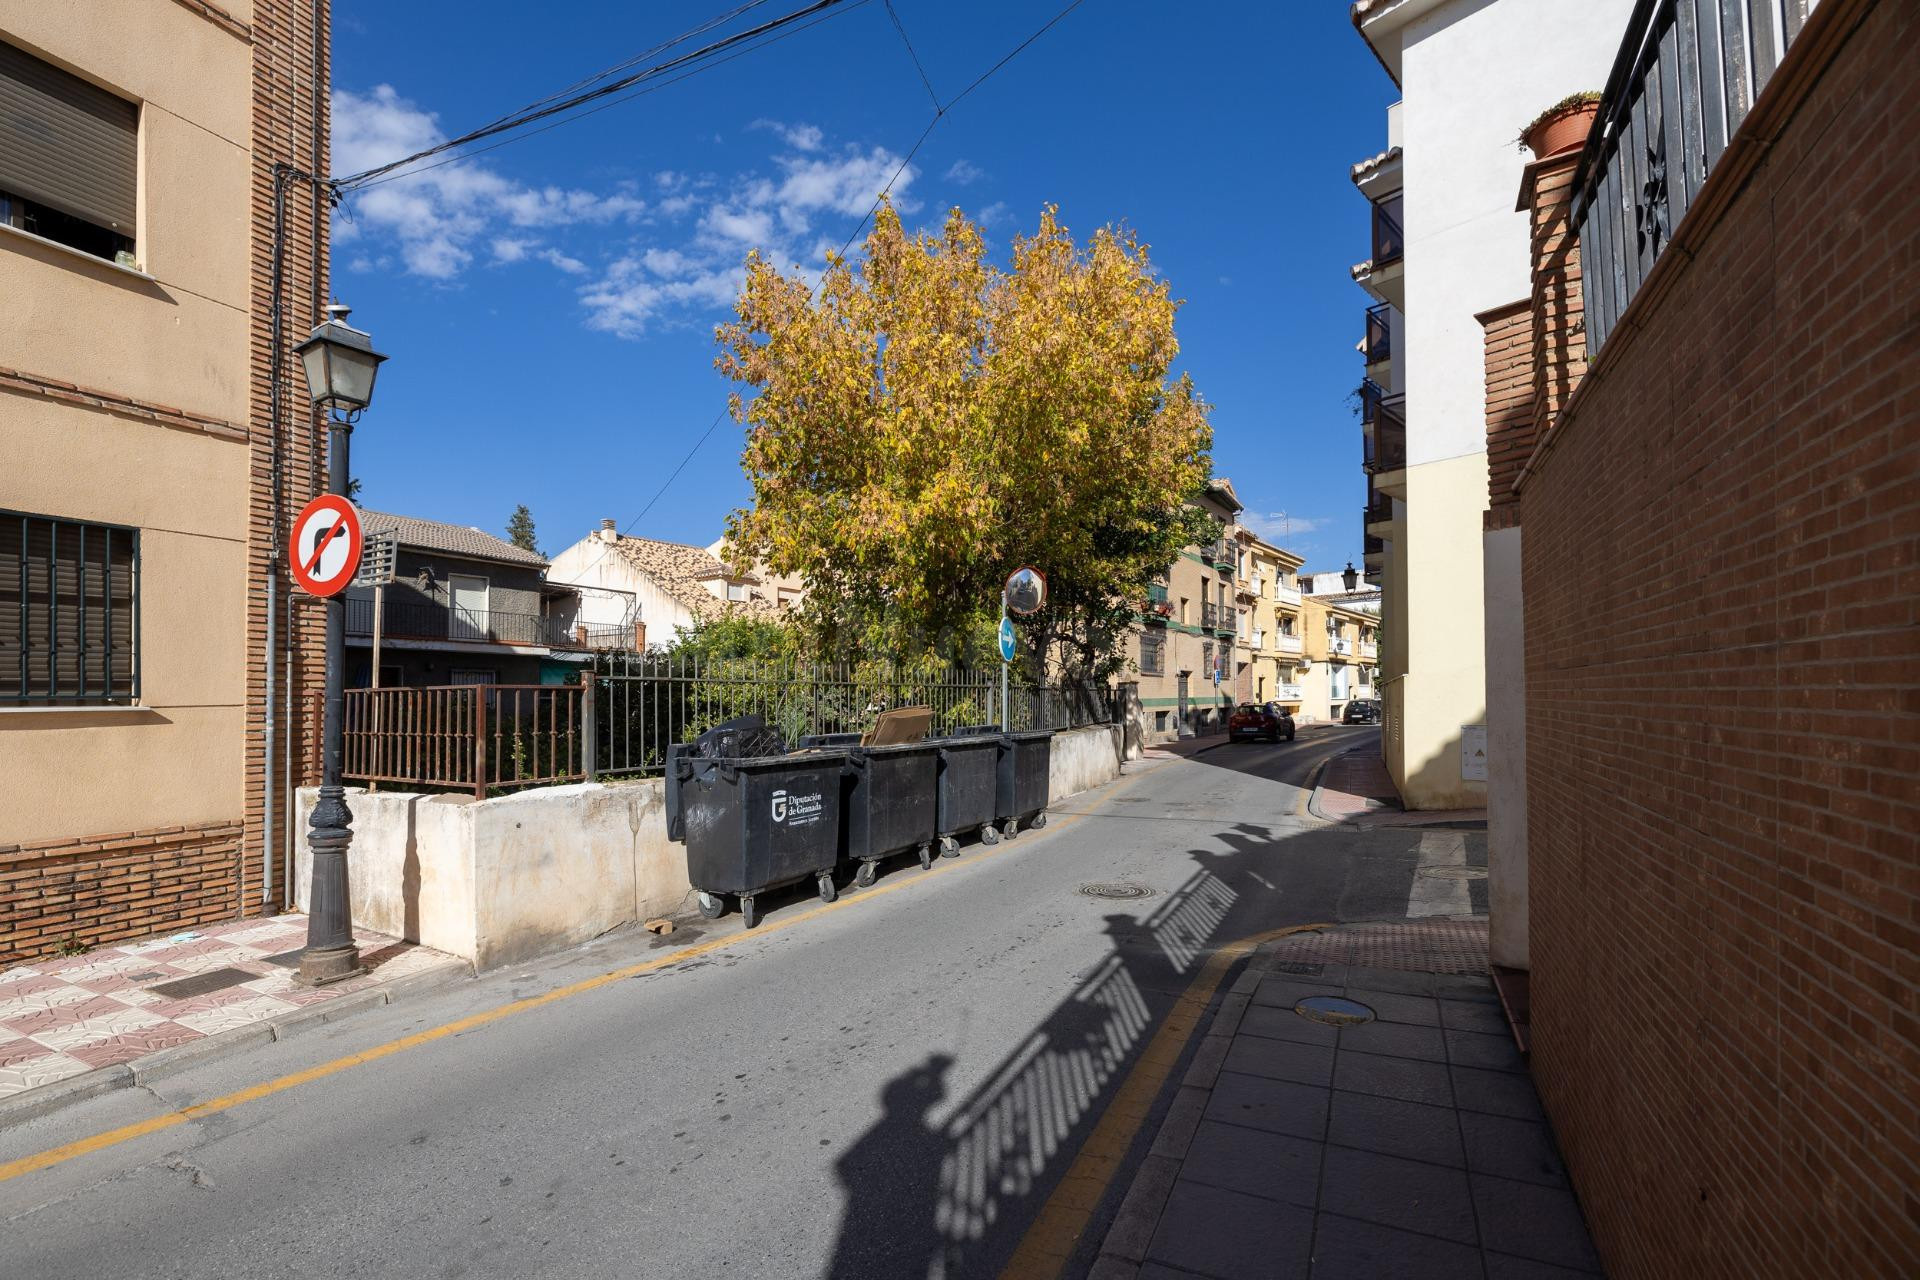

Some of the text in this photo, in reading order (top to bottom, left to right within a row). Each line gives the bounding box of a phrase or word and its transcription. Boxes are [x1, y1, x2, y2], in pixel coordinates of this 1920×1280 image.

[788, 793, 822, 806] Diputación
[788, 802, 822, 816] de Granada
